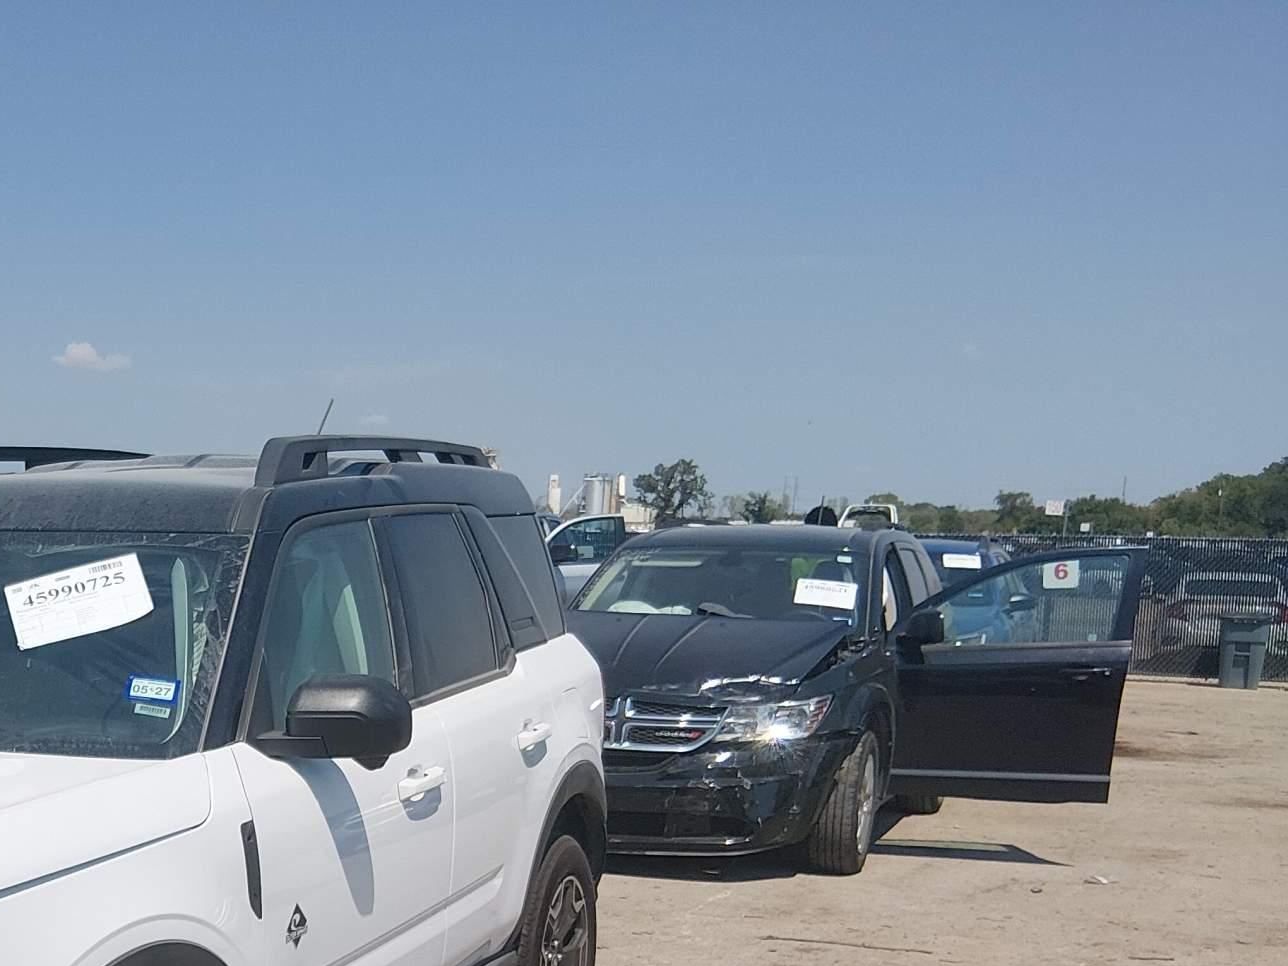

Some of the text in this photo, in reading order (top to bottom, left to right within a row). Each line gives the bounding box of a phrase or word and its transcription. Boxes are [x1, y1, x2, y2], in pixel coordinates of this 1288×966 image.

[1053, 563, 1069, 580] 6
[23, 571, 126, 608] 45990725
[132, 684, 172, 697] 05 27
